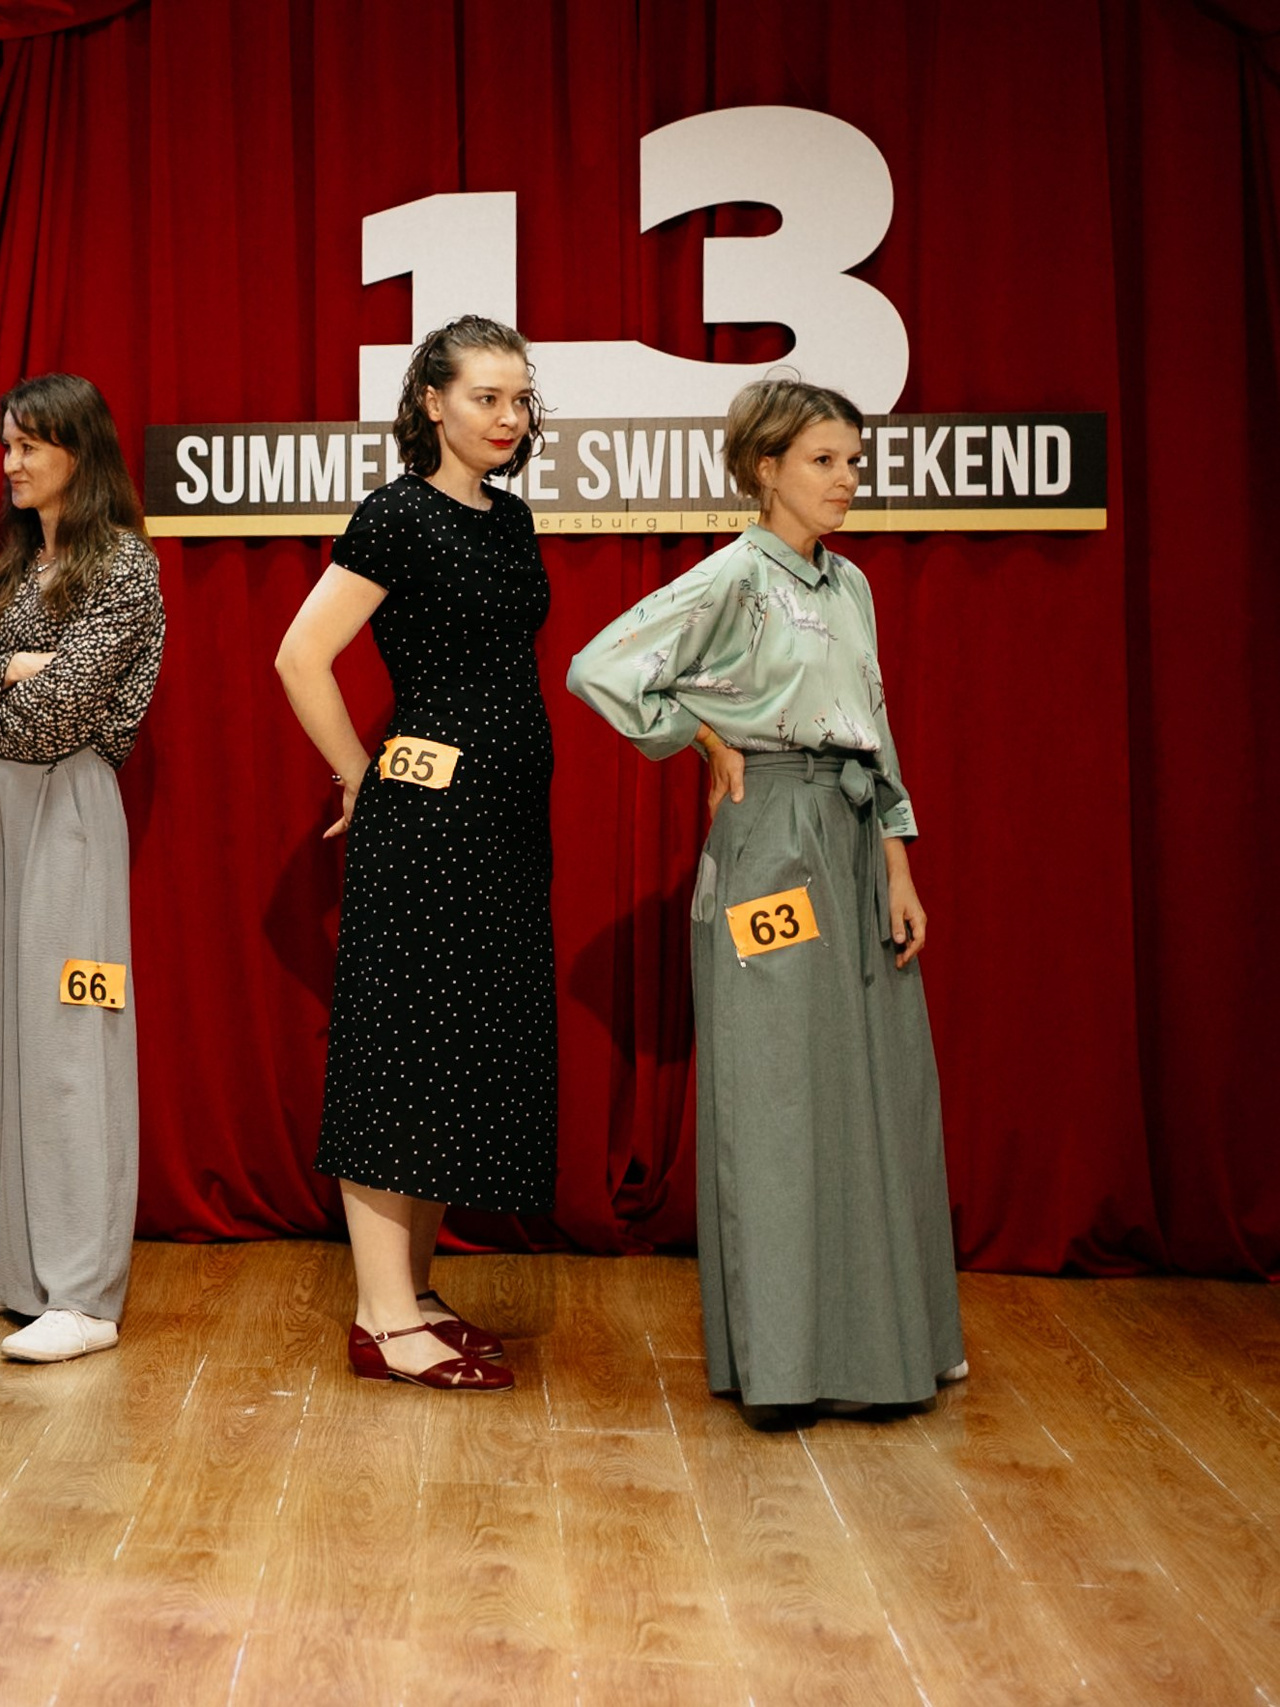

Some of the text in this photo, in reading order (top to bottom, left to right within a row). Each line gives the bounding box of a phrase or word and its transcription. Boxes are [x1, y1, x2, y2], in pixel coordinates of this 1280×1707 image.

[359, 105, 910, 420] 13
[577, 429, 752, 500] SWIN
[854, 425, 1071, 497] EKEND
[540, 513, 757, 531] ersburg Rus
[389, 746, 438, 782] 65
[750, 903, 800, 946] 63
[68, 969, 116, 1005] 66.
